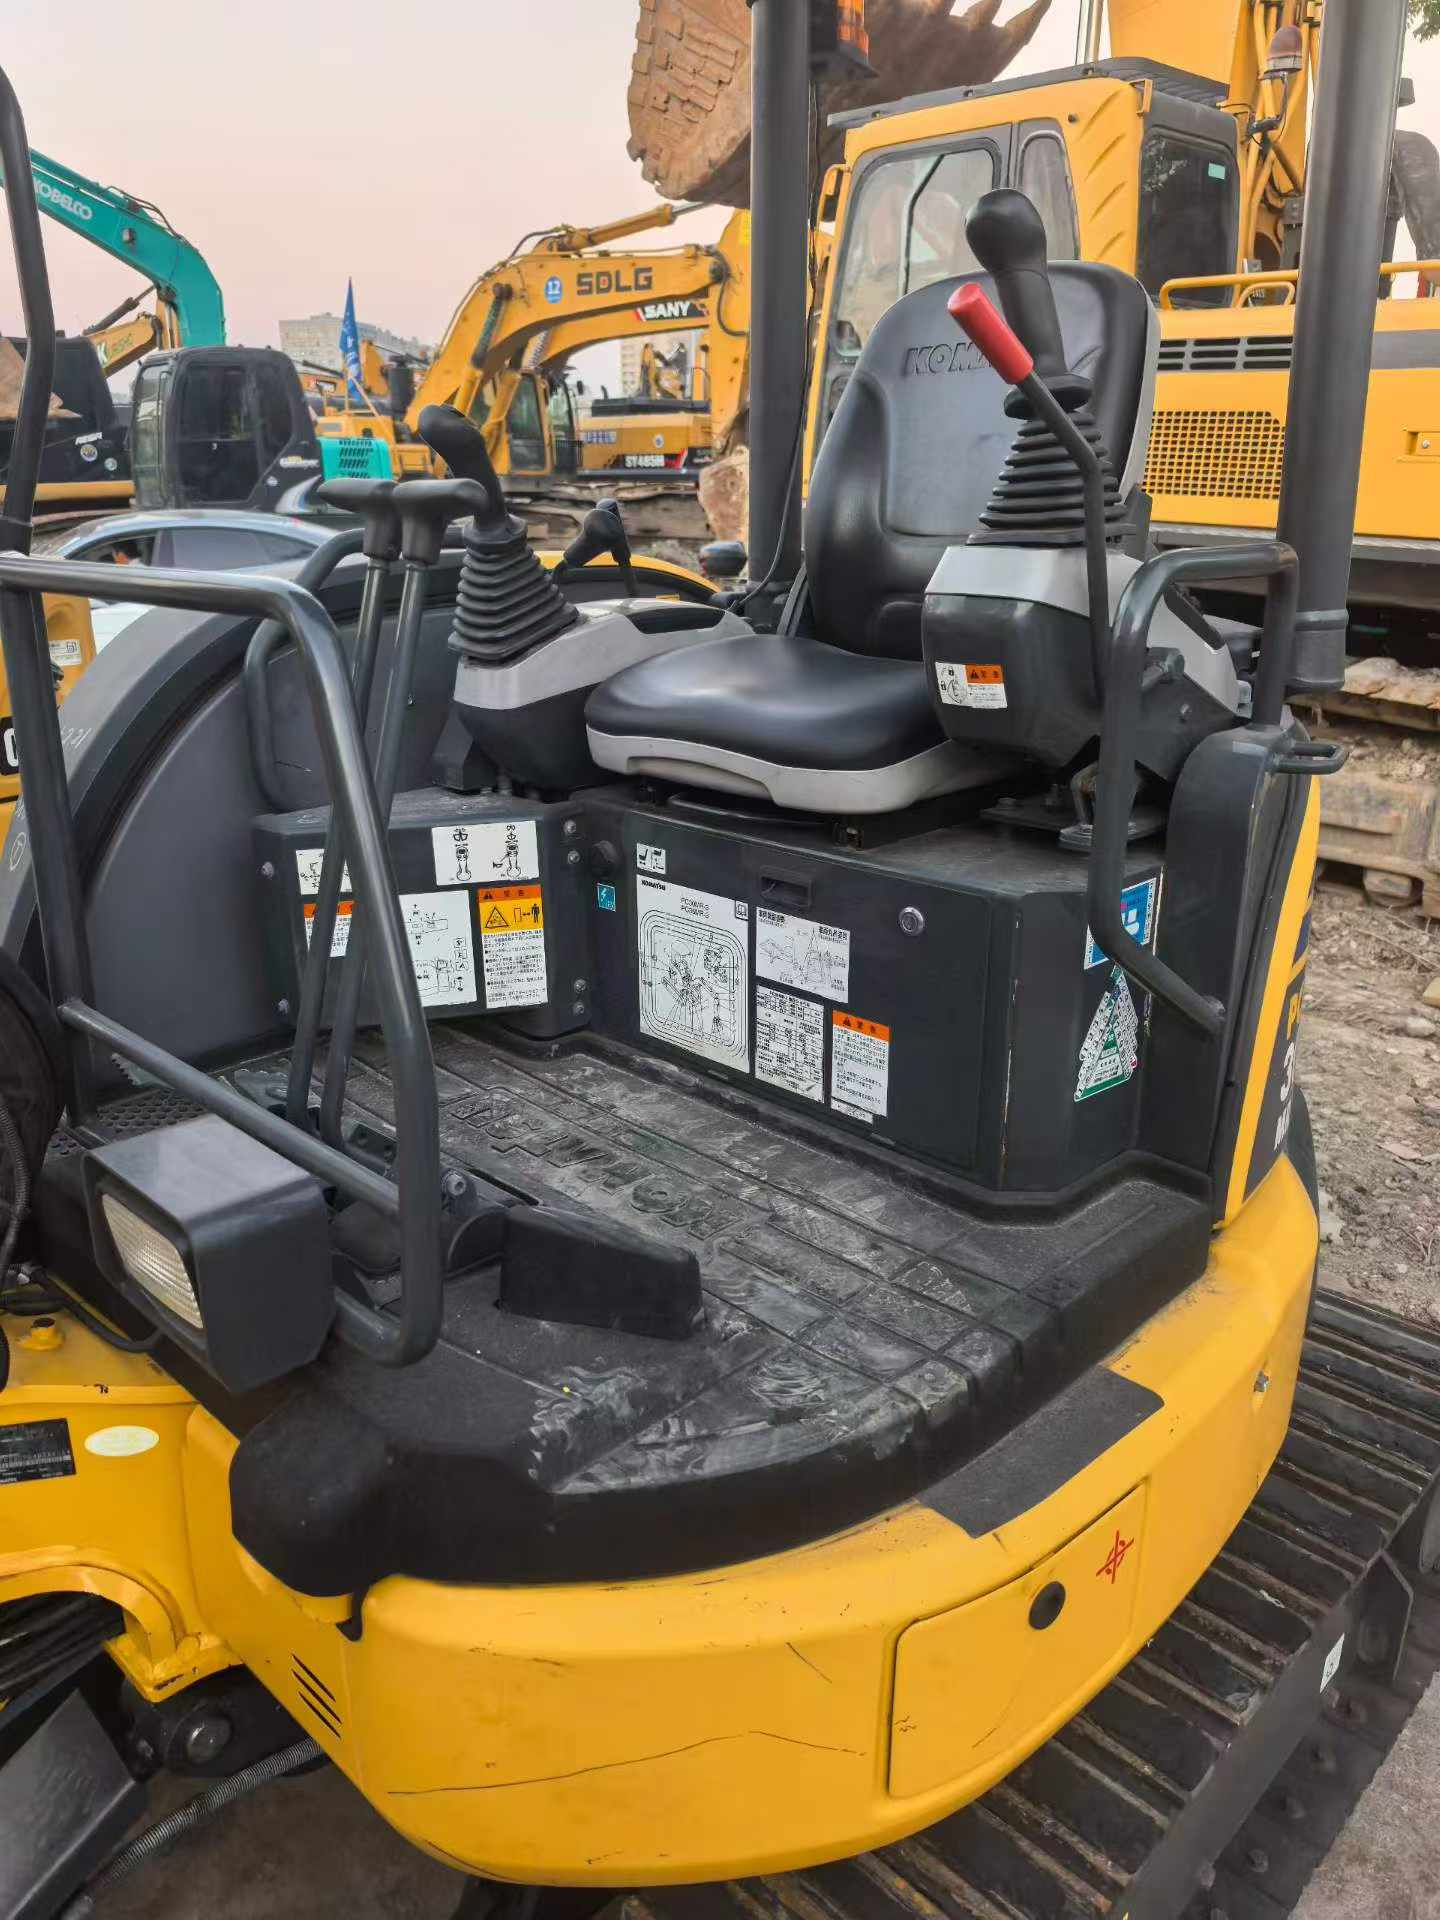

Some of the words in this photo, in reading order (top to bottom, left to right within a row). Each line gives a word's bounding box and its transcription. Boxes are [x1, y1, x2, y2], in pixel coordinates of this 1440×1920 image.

[576, 267, 653, 297] SDLG
[644, 301, 691, 319] SANY
[903, 343, 991, 377] KOM
[641, 879, 666, 891] KOMATSU
[449, 1091, 746, 1242] KOMATSU
